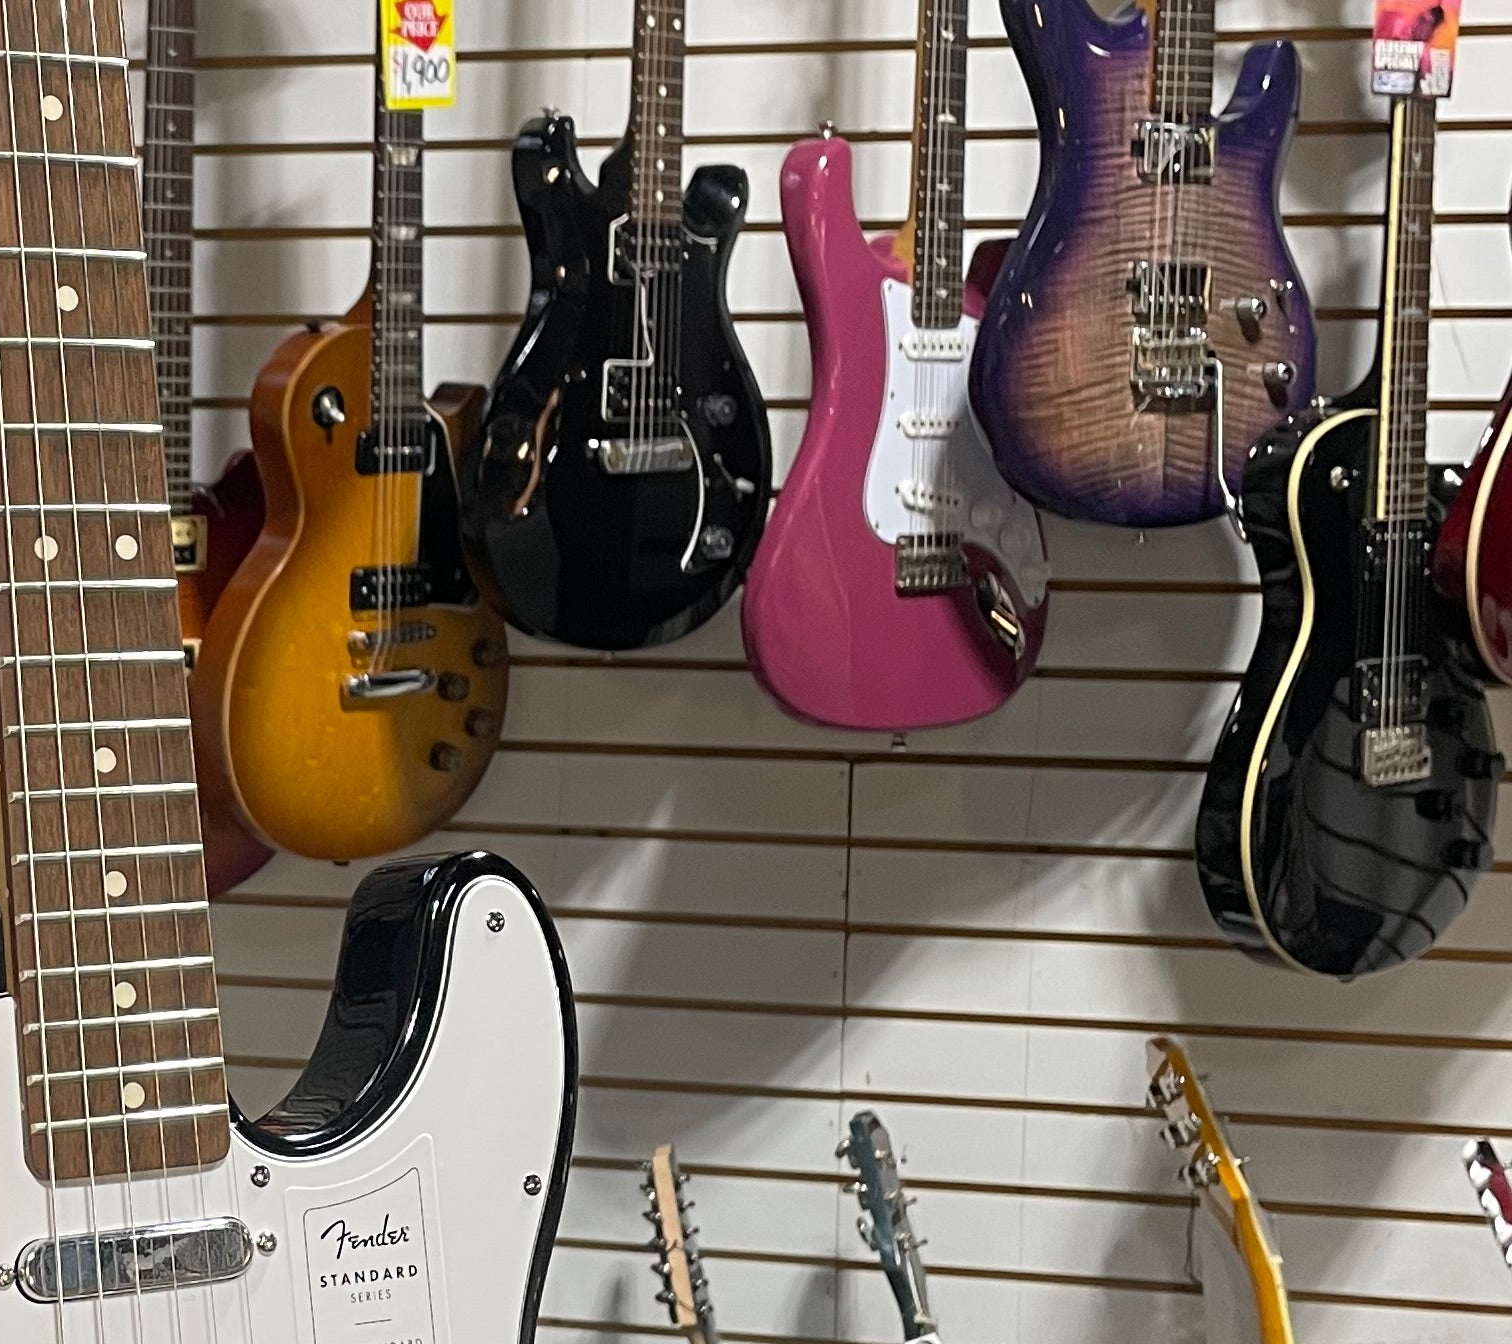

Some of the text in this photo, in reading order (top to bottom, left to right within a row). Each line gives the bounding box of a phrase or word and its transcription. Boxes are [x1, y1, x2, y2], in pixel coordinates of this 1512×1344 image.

[403, 3, 435, 22] OUR
[401, 19, 439, 39] PRICE
[320, 1214, 410, 1259] Fender
[320, 1264, 419, 1289] STANDARD
[350, 1288, 392, 1304] SERIES
